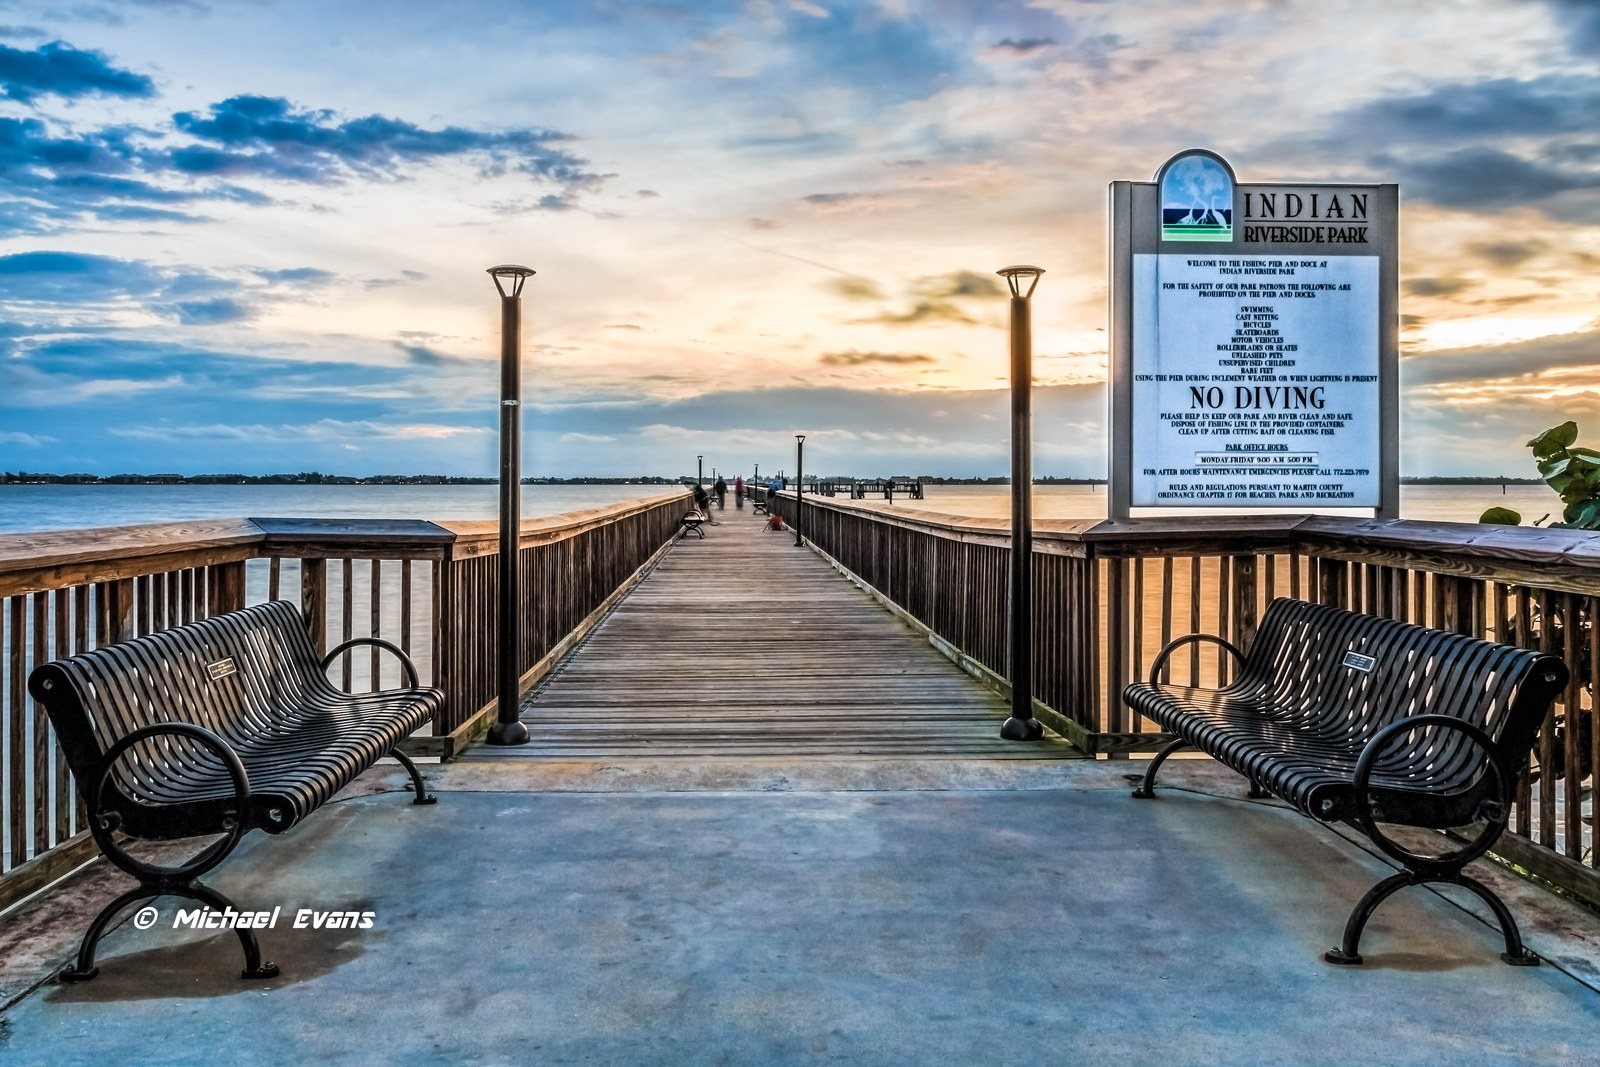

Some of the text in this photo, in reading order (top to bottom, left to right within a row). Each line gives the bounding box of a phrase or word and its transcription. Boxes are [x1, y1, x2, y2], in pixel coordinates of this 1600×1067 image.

[1244, 193, 1368, 218] INDIAN
[1244, 226, 1369, 244] RIVERSIDE PARK
[1187, 260, 1328, 268] WELCOME TO THE FISHING PIER AND DOCK AT
[1162, 283, 1351, 292] FOR THE SAFETY OF OUR PARK PATRONS THE FOLLOWING ARE
[1189, 386, 1326, 409] NO DIVING
